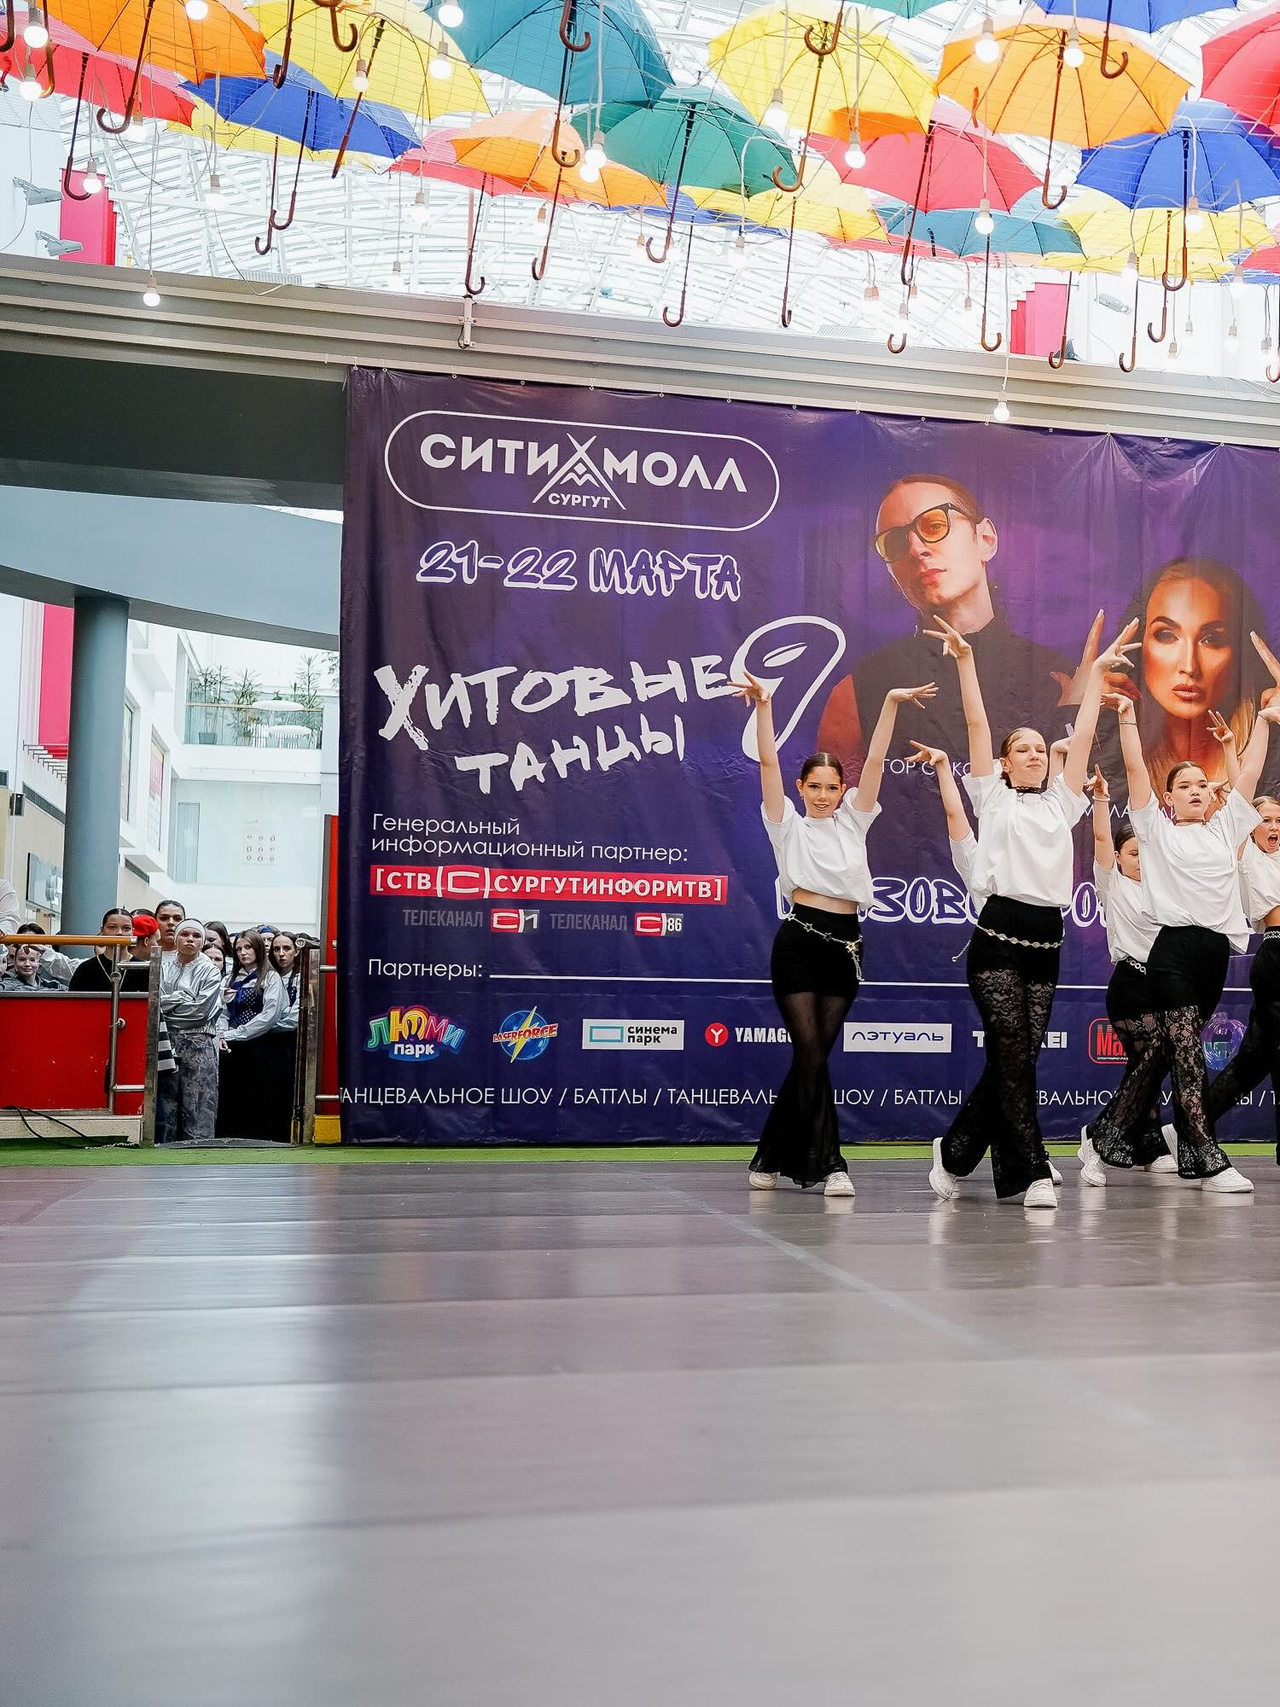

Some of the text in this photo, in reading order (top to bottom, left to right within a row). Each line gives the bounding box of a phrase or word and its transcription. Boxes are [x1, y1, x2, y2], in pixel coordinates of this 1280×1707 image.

[420, 433, 748, 493] СИТИ МОЛЛ
[548, 493, 611, 509] СУРГУТ
[415, 540, 740, 602] 21-22 МАРТА
[373, 655, 735, 751] ХИТОВЫЕ
[456, 714, 686, 795] ТАНЦЫ
[881, 759, 916, 774] ГОР
[372, 813, 520, 837] Генеральный
[371, 836, 689, 864] информационный партнер:
[402, 909, 484, 928] ТЕЛЕКАНАЛ
[550, 913, 628, 931] ТЕЛЕКАНАЛ
[368, 959, 483, 980] Партнеры:
[493, 1023, 558, 1042] LASERFORCE
[627, 1026, 677, 1035] синема
[627, 1035, 661, 1046] парк
[735, 1027, 792, 1043] YAMAG
[393, 1043, 435, 1058] парк
[501, 1087, 553, 1105] ШОУ
[573, 1088, 647, 1104] БАТТЛЫ
[667, 1088, 778, 1104] ТАНЦЕВАЛЬ
[894, 1089, 962, 1105] БАТТЛЫ
